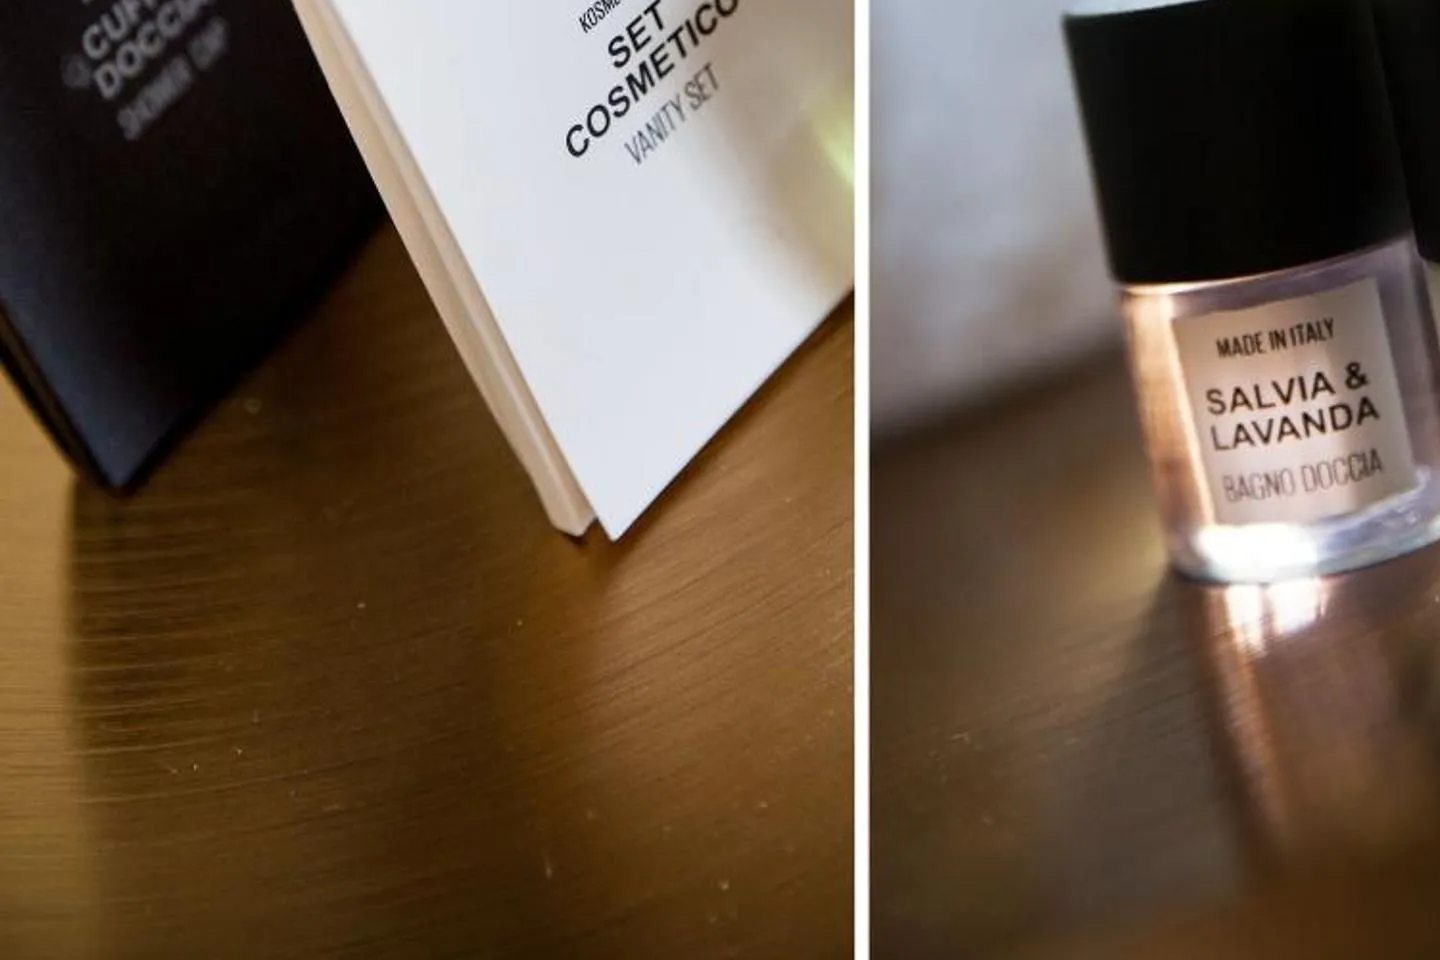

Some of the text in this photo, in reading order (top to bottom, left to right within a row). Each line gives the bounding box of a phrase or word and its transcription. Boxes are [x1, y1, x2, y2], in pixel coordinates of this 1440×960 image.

[624, 61, 719, 166] VANITY SET
[1216, 317, 1334, 358] MADE IN ITALY
[1206, 361, 1368, 416] SALVIA &
[1211, 396, 1379, 451] LAVANDA
[1222, 449, 1383, 502] BAGNO DOCCIA
